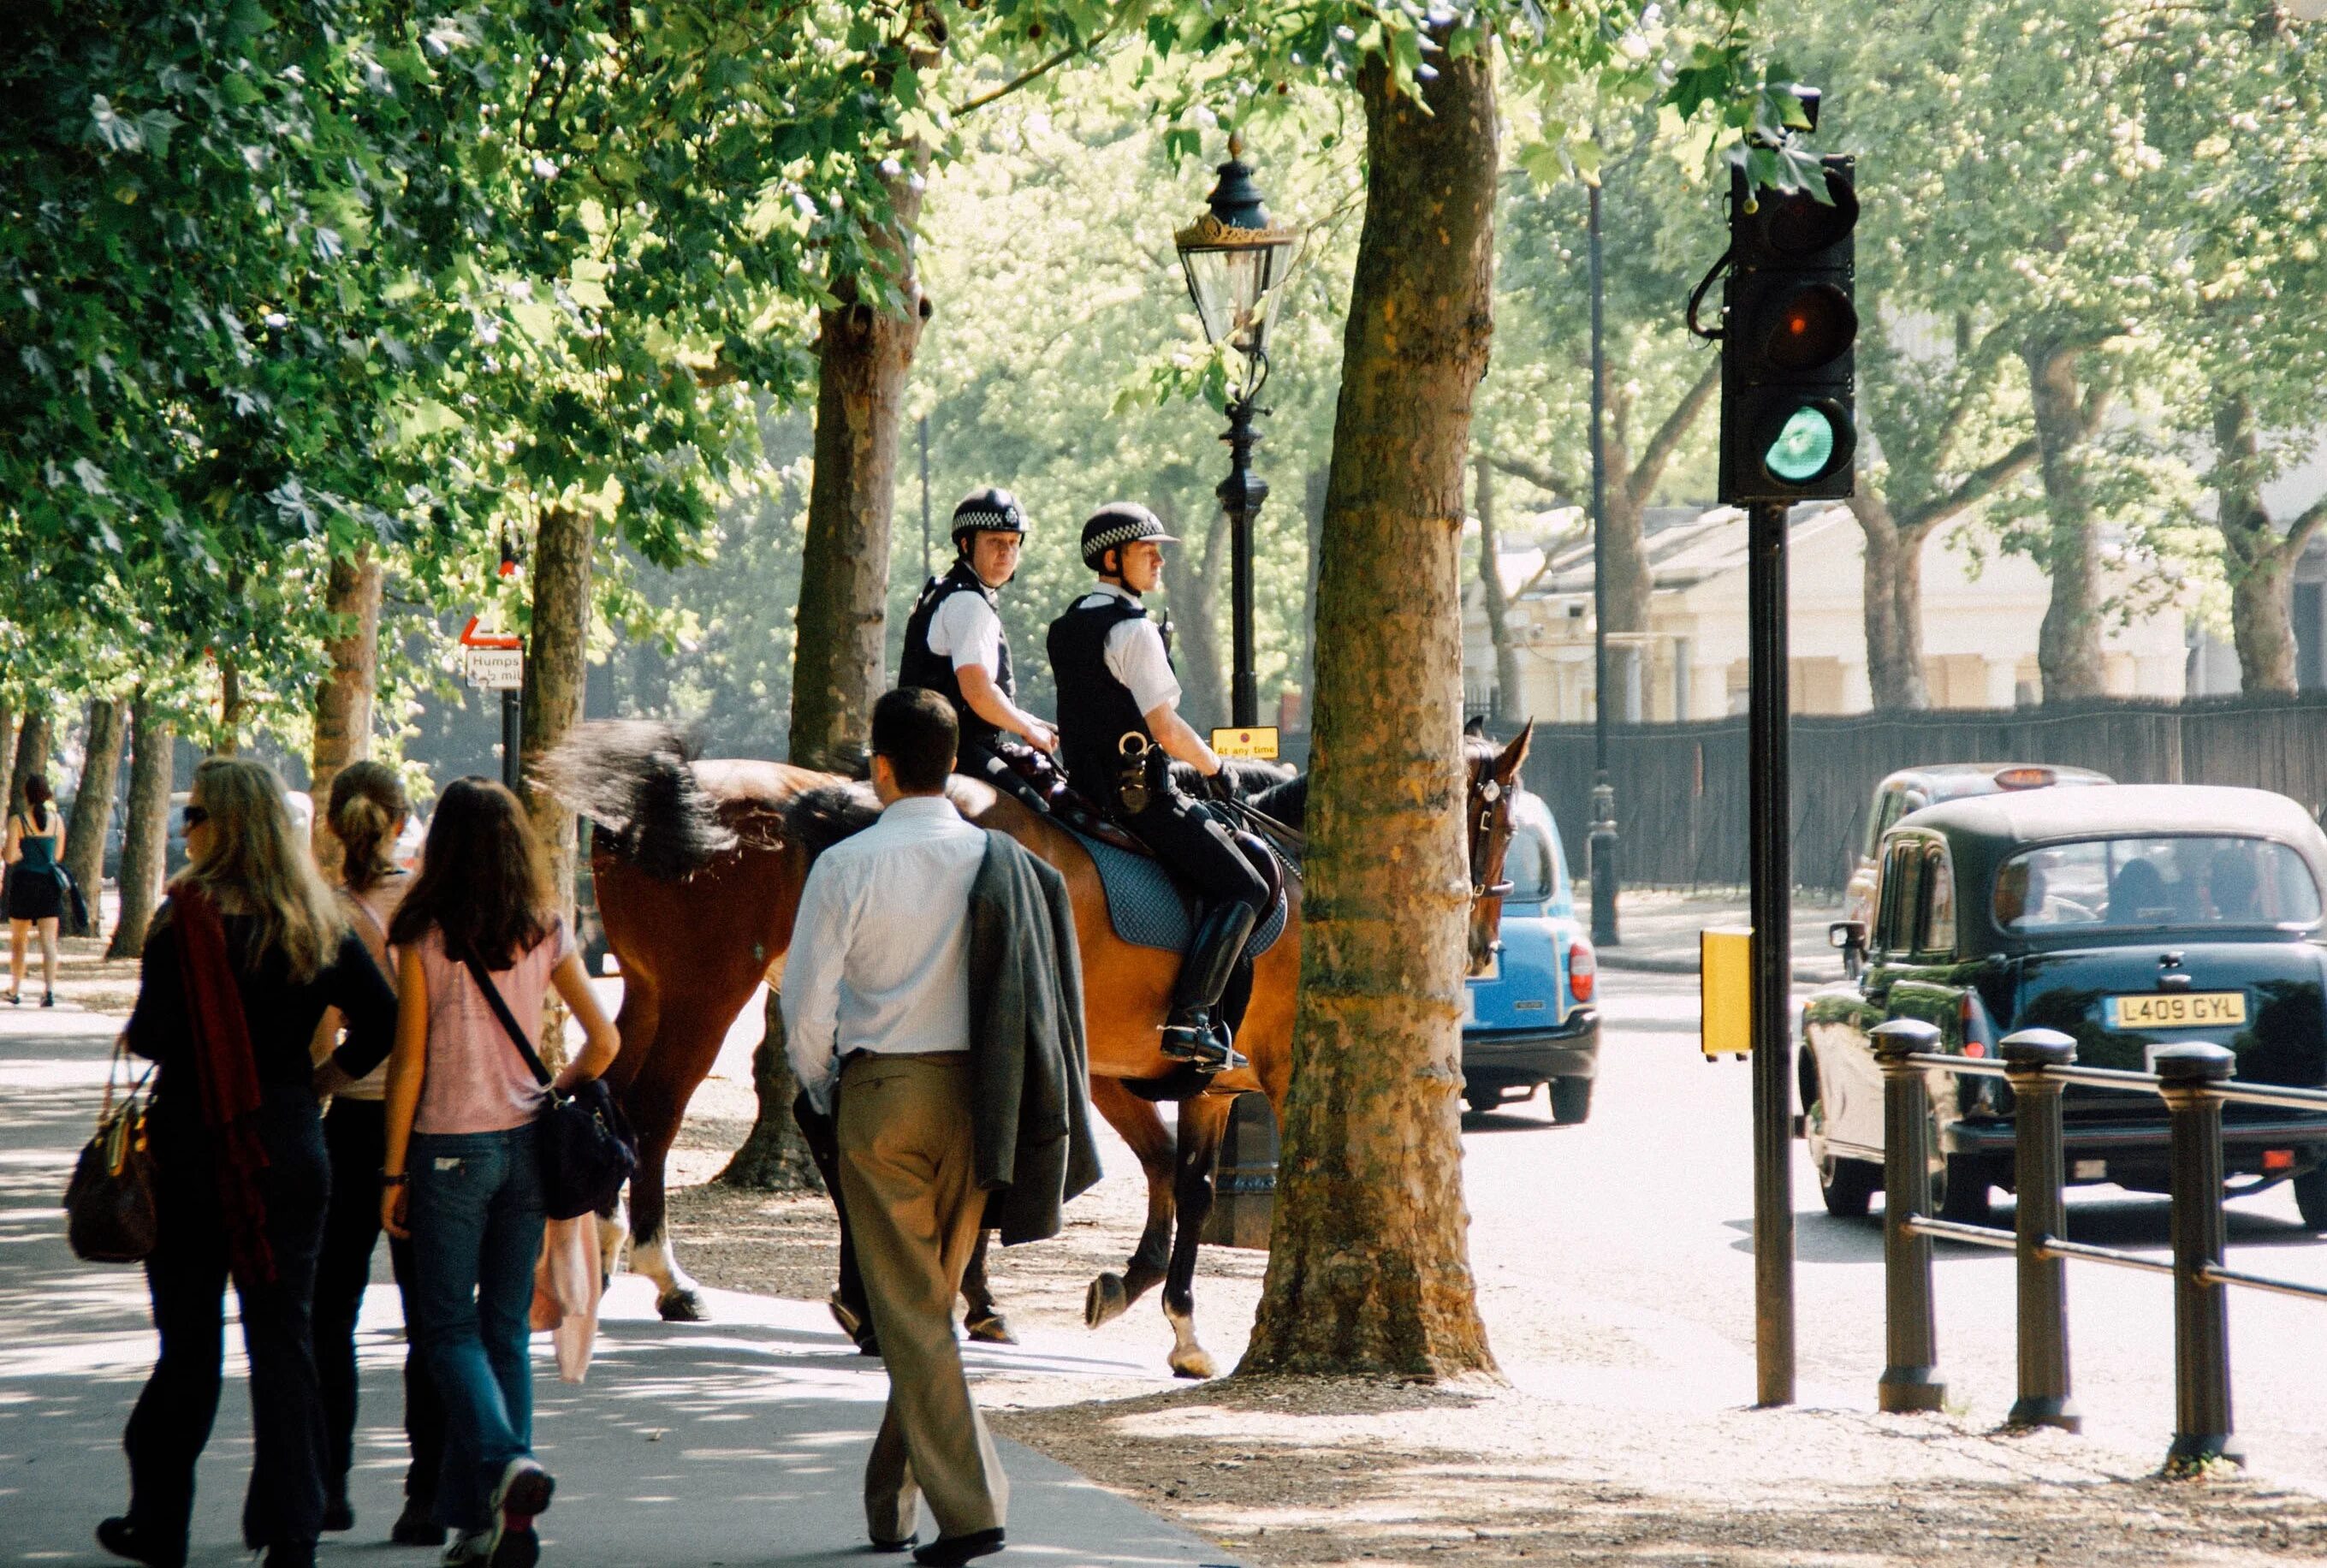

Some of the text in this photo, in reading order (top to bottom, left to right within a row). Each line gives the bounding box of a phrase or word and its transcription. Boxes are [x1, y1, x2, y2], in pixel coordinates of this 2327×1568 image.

[473, 656, 519, 668] Humps
[502, 671, 521, 681] mil
[2123, 996, 2240, 1021] L409 GYL
